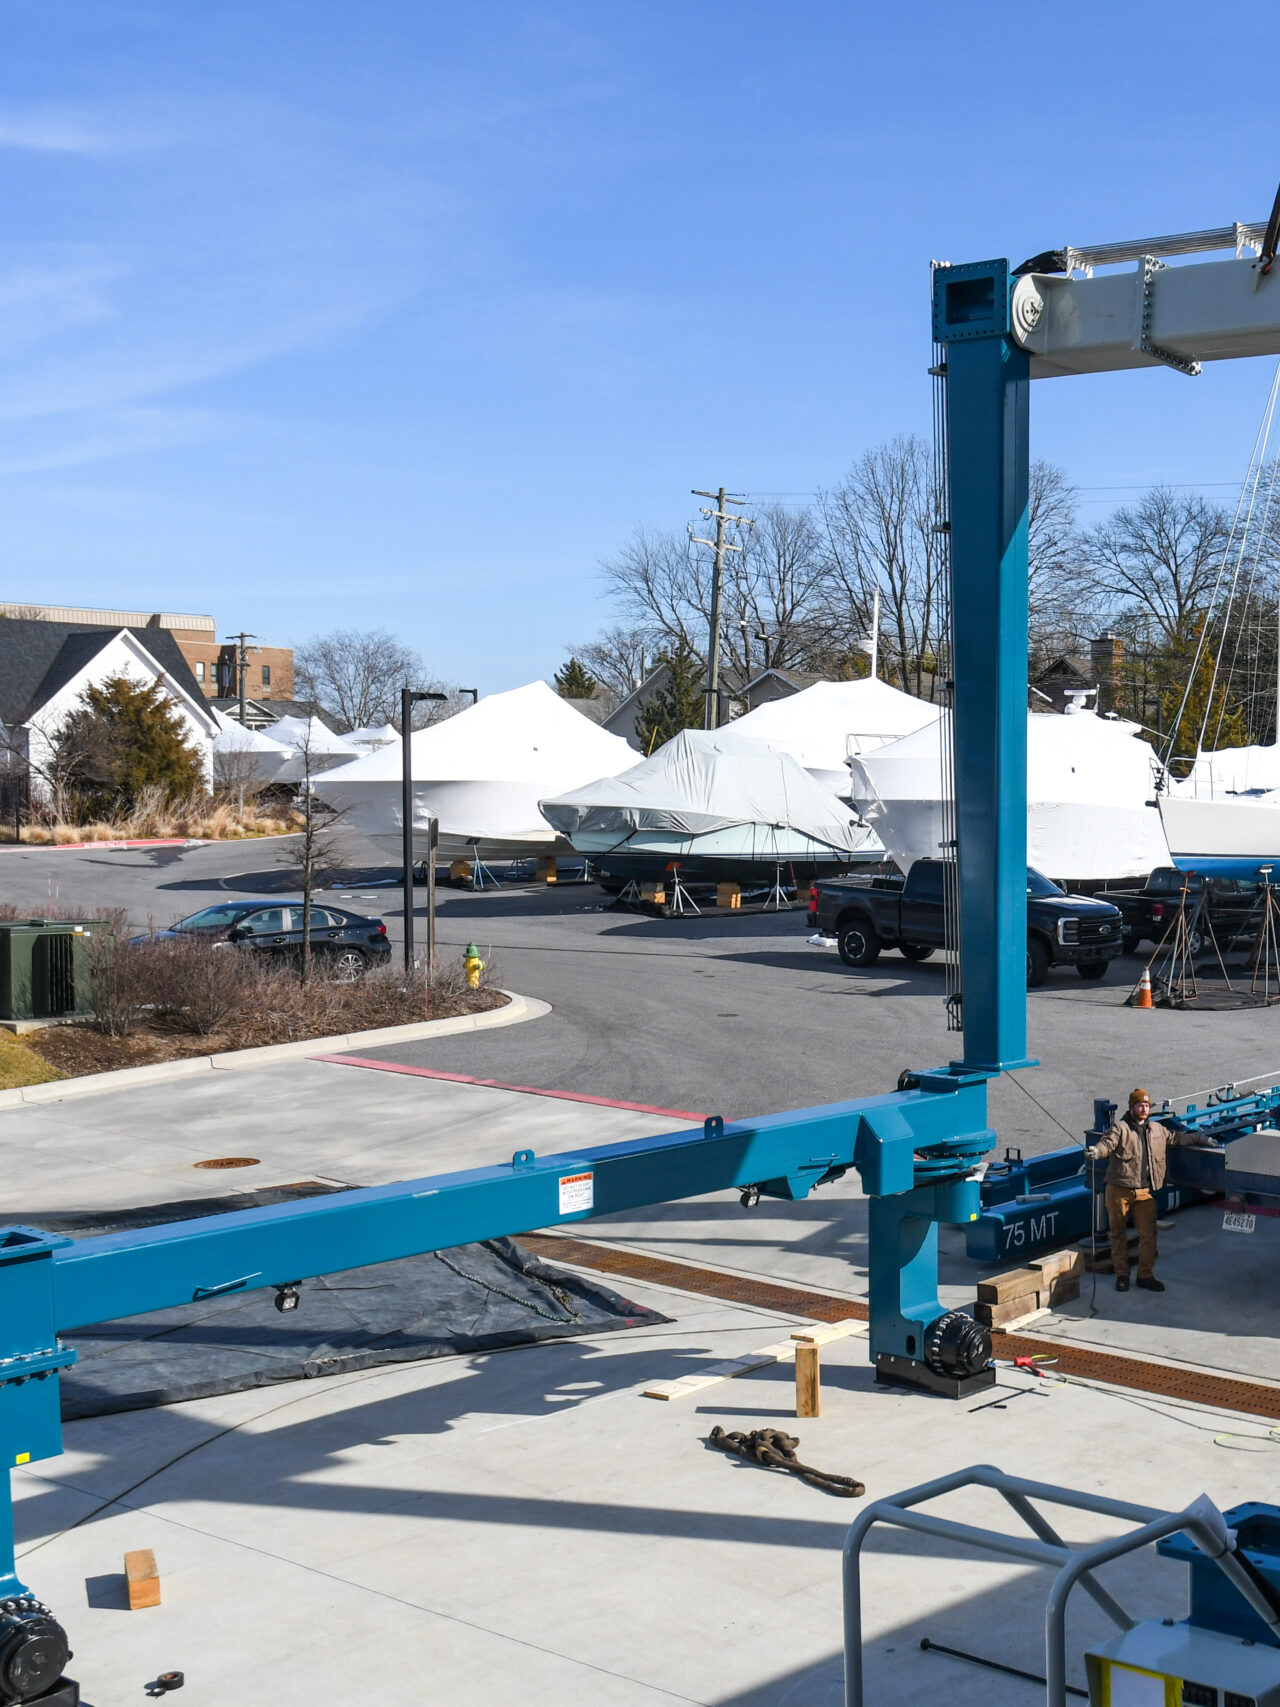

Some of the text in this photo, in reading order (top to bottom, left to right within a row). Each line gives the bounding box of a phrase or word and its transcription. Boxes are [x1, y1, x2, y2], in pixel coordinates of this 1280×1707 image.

[566, 1173, 592, 1184] WARNING
[1003, 1211, 1059, 1250] 75 MT
